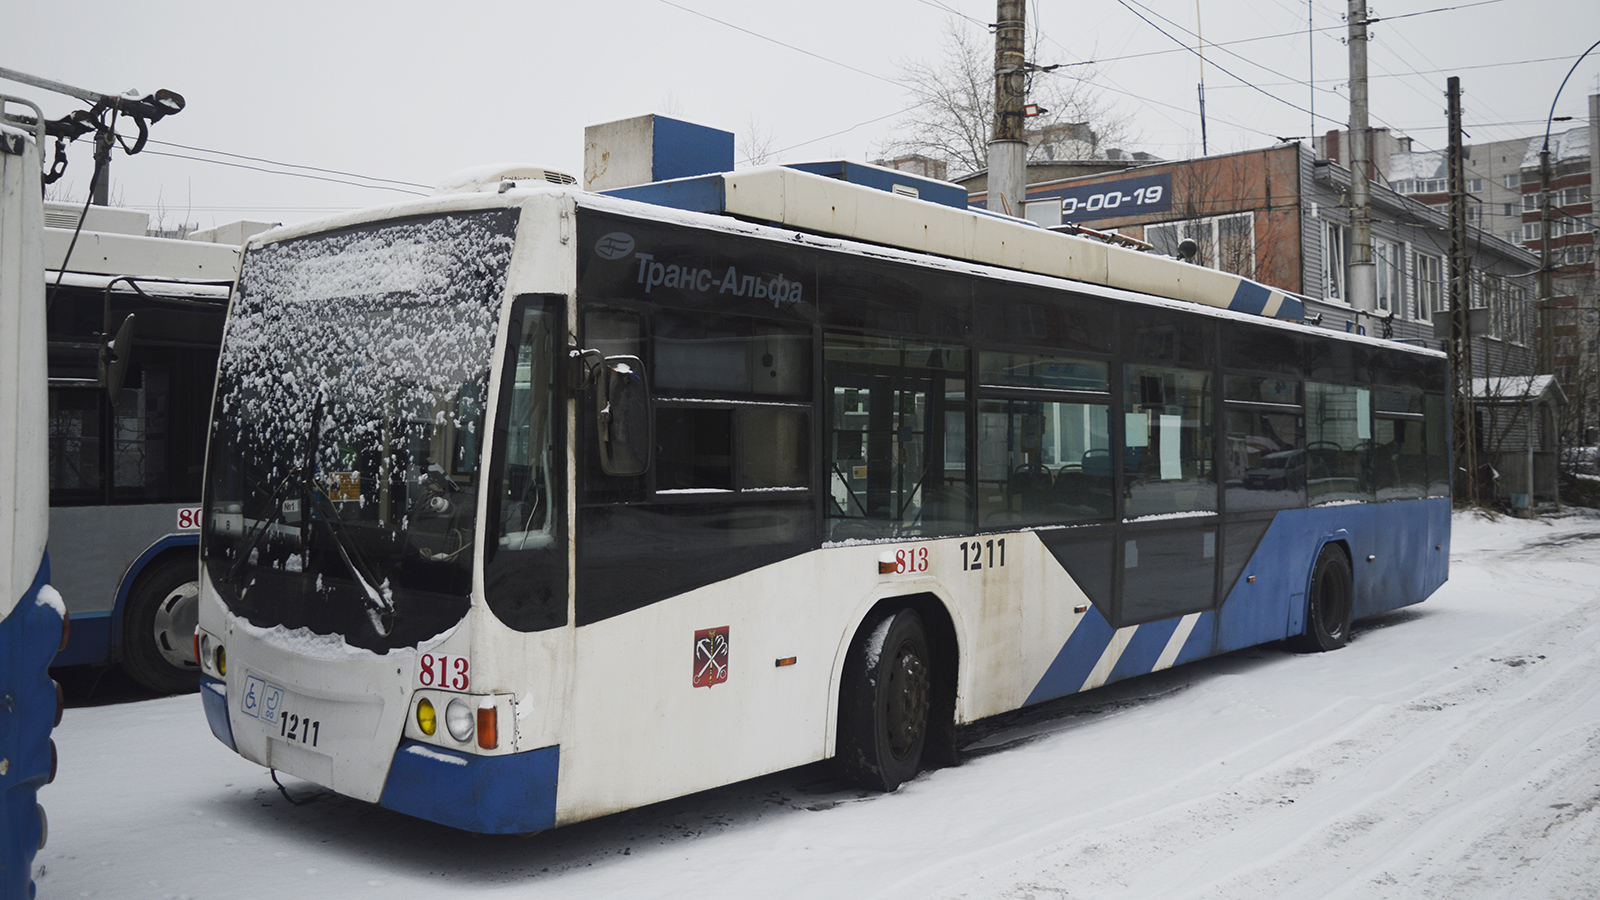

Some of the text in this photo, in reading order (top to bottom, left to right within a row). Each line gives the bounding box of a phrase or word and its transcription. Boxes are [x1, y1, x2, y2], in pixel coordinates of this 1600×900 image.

[634, 252, 803, 308] Транс-Альфа
[895, 547, 929, 574] 813
[960, 538, 1005, 571] 1211
[419, 653, 469, 690] 813
[280, 711, 320, 747] 1211
